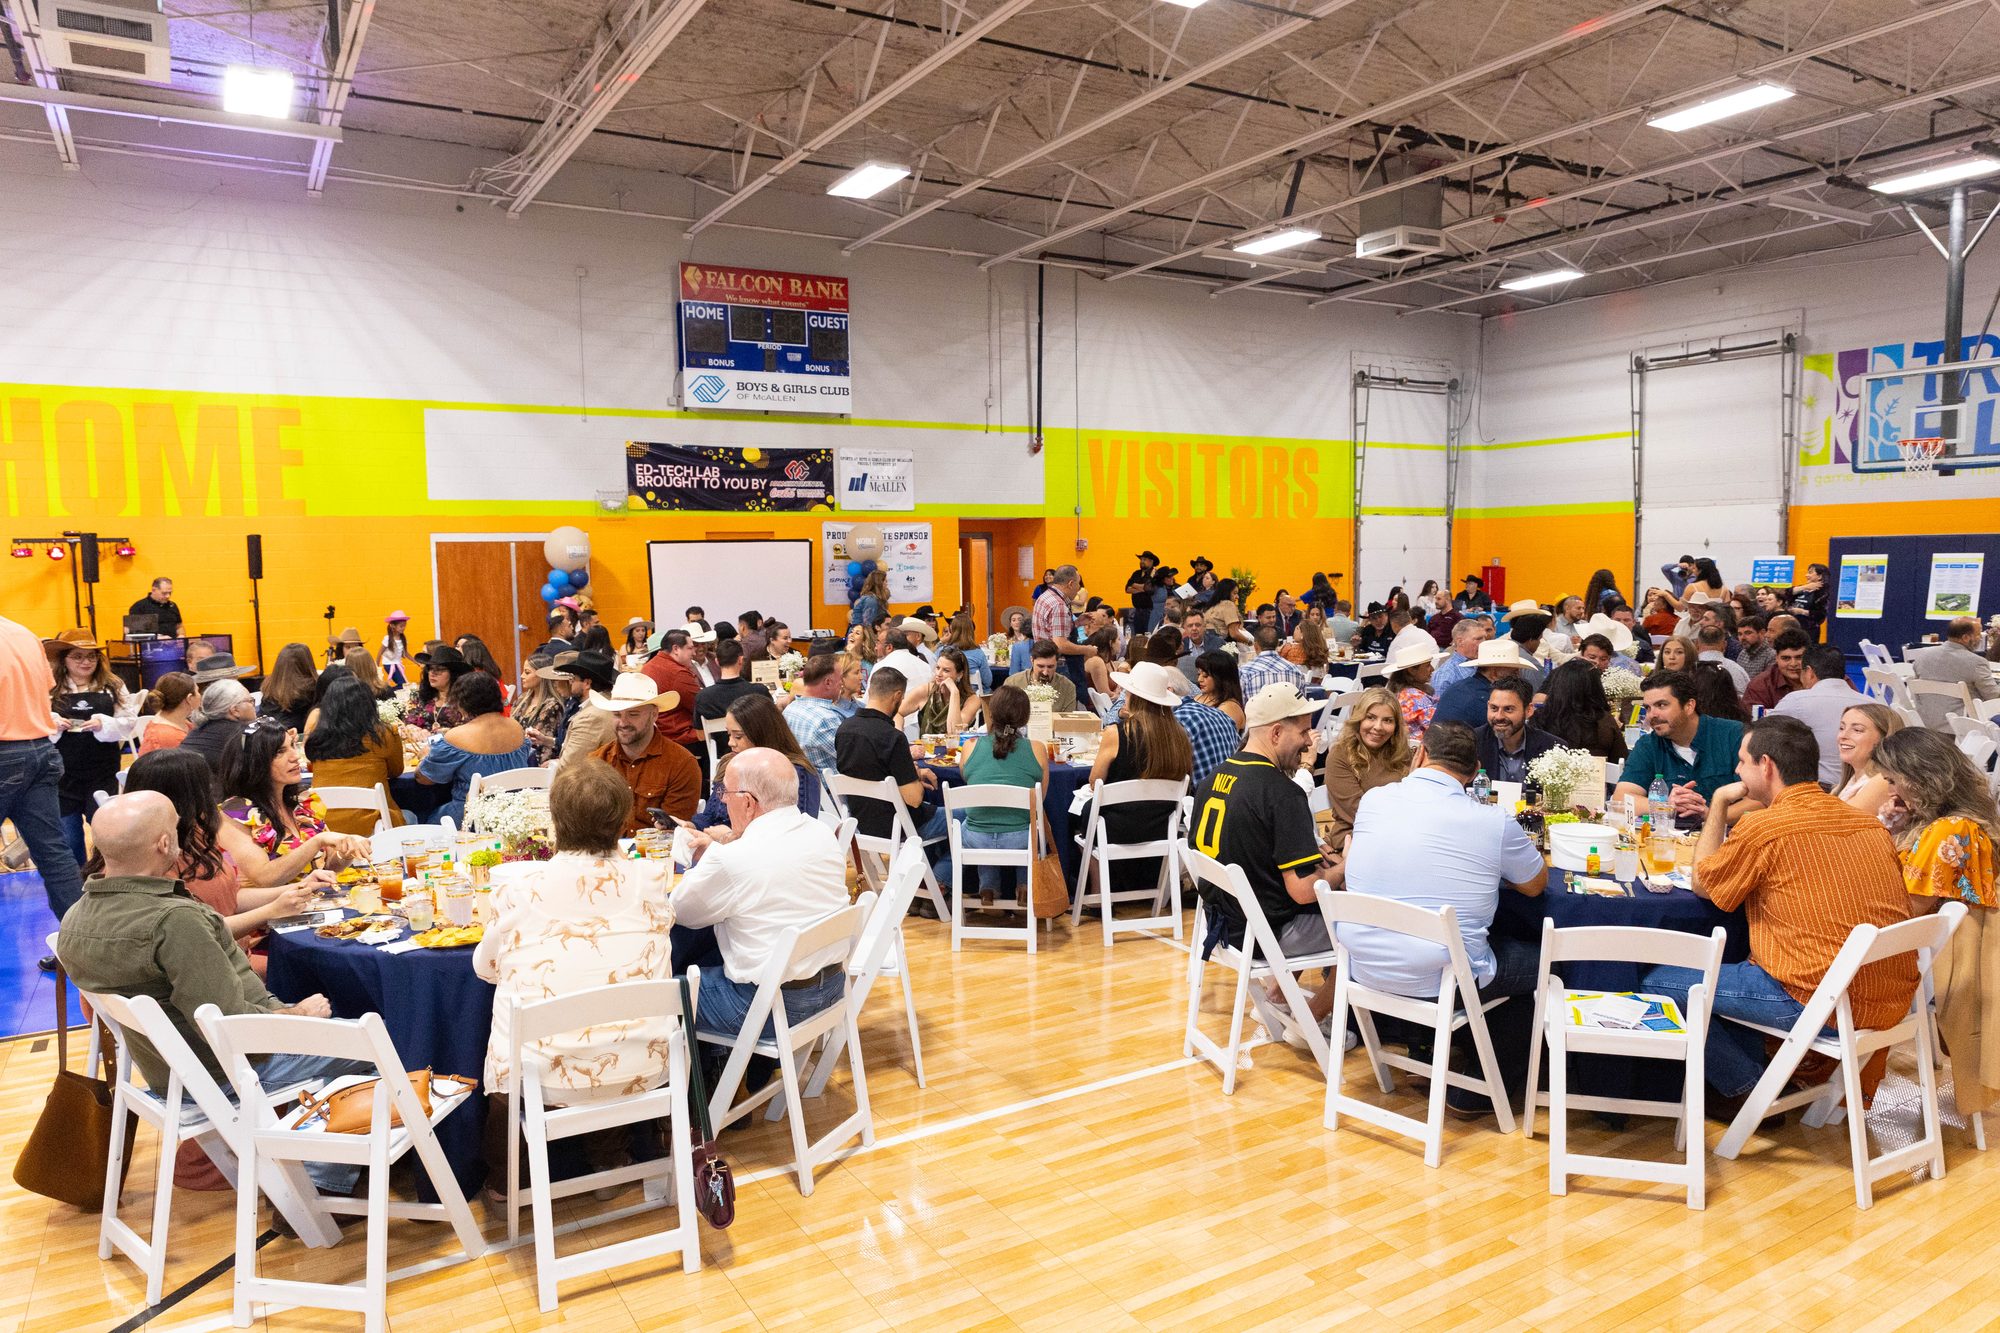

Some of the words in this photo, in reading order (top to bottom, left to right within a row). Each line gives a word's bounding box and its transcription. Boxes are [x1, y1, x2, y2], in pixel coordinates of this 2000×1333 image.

[705, 270, 783, 295] FALCON
[789, 278, 847, 300] BANK
[725, 293, 738, 302] We
[739, 295, 760, 304] know
[761, 296, 780, 306] what
[685, 305, 725, 321] HOME
[808, 315, 848, 330] GUEST
[757, 343, 783, 351] PERIOD
[708, 358, 735, 368] BONUS
[805, 364, 830, 373] BONUS
[736, 381, 768, 392] BOYS
[770, 383, 781, 393] &
[783, 384, 817, 395] GIRLS
[820, 386, 850, 396] CLUB
[752, 394, 796, 402] McALLEN
[0, 397, 306, 516] HOME
[635, 463, 694, 477] ED-TECH
[696, 465, 720, 477] LAB
[636, 475, 699, 489] BROUGHT
[702, 477, 720, 489] TO
[722, 478, 750, 490] YOU
[752, 478, 767, 490] BY
[1088, 439, 1319, 519] VISITORS
[1815, 469, 1855, 487] game
[870, 481, 907, 493] McALLEN
[826, 531, 849, 540] PROU
[894, 532, 929, 540] SPONSOR
[1212, 772, 1238, 795] NICK
[1195, 796, 1226, 859] 0
